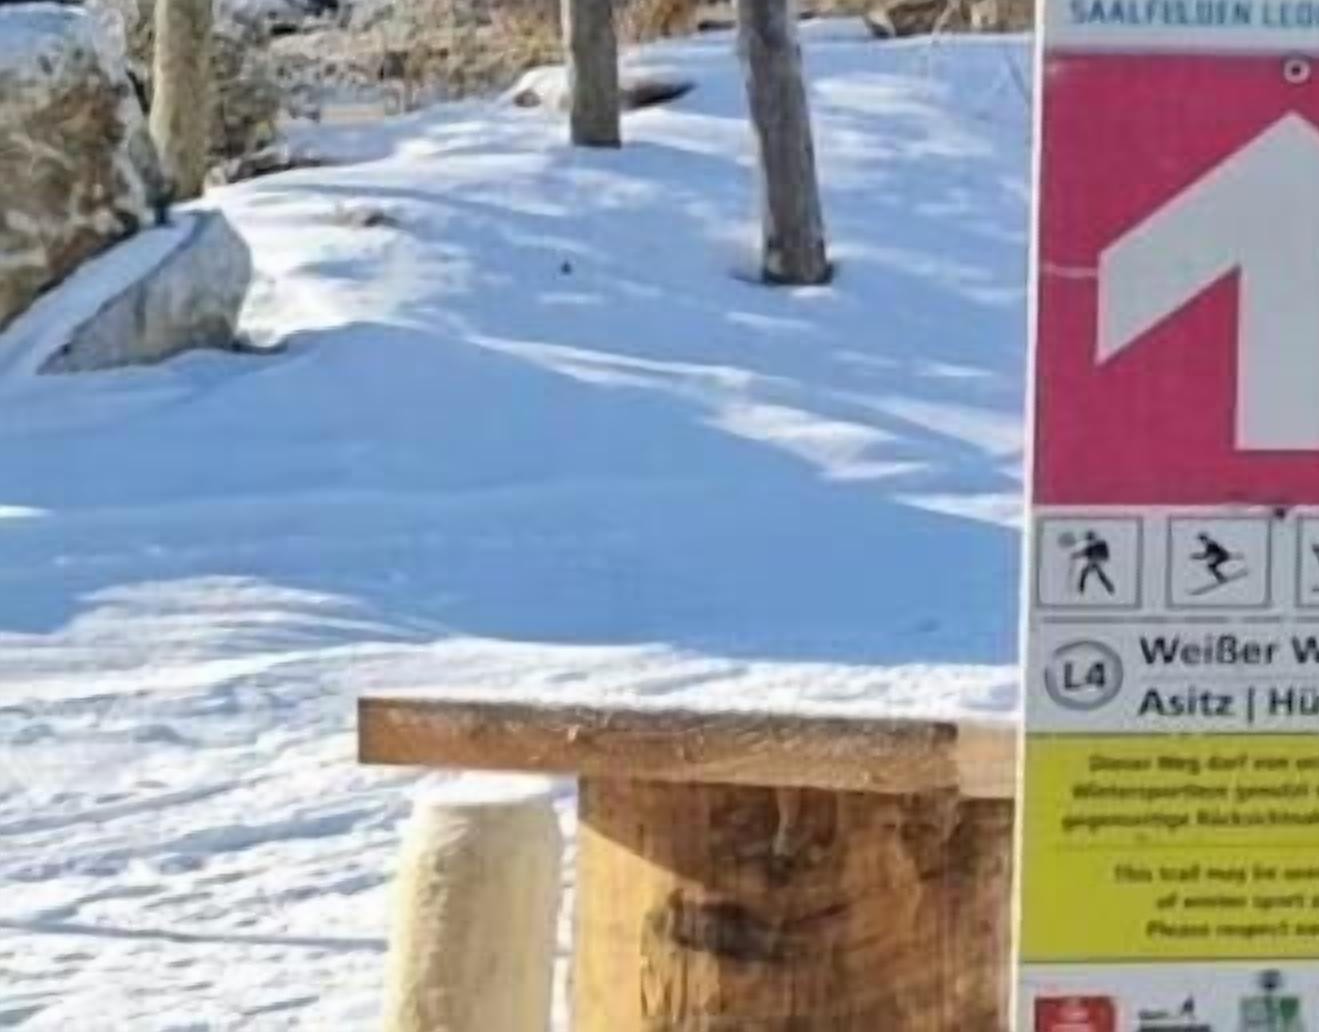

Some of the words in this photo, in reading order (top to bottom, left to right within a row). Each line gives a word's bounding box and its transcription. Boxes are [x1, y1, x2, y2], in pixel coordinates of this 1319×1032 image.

[1138, 634, 1279, 666] Weißer
[1063, 661, 1107, 691] L4
[1137, 687, 1234, 717] Asitz
